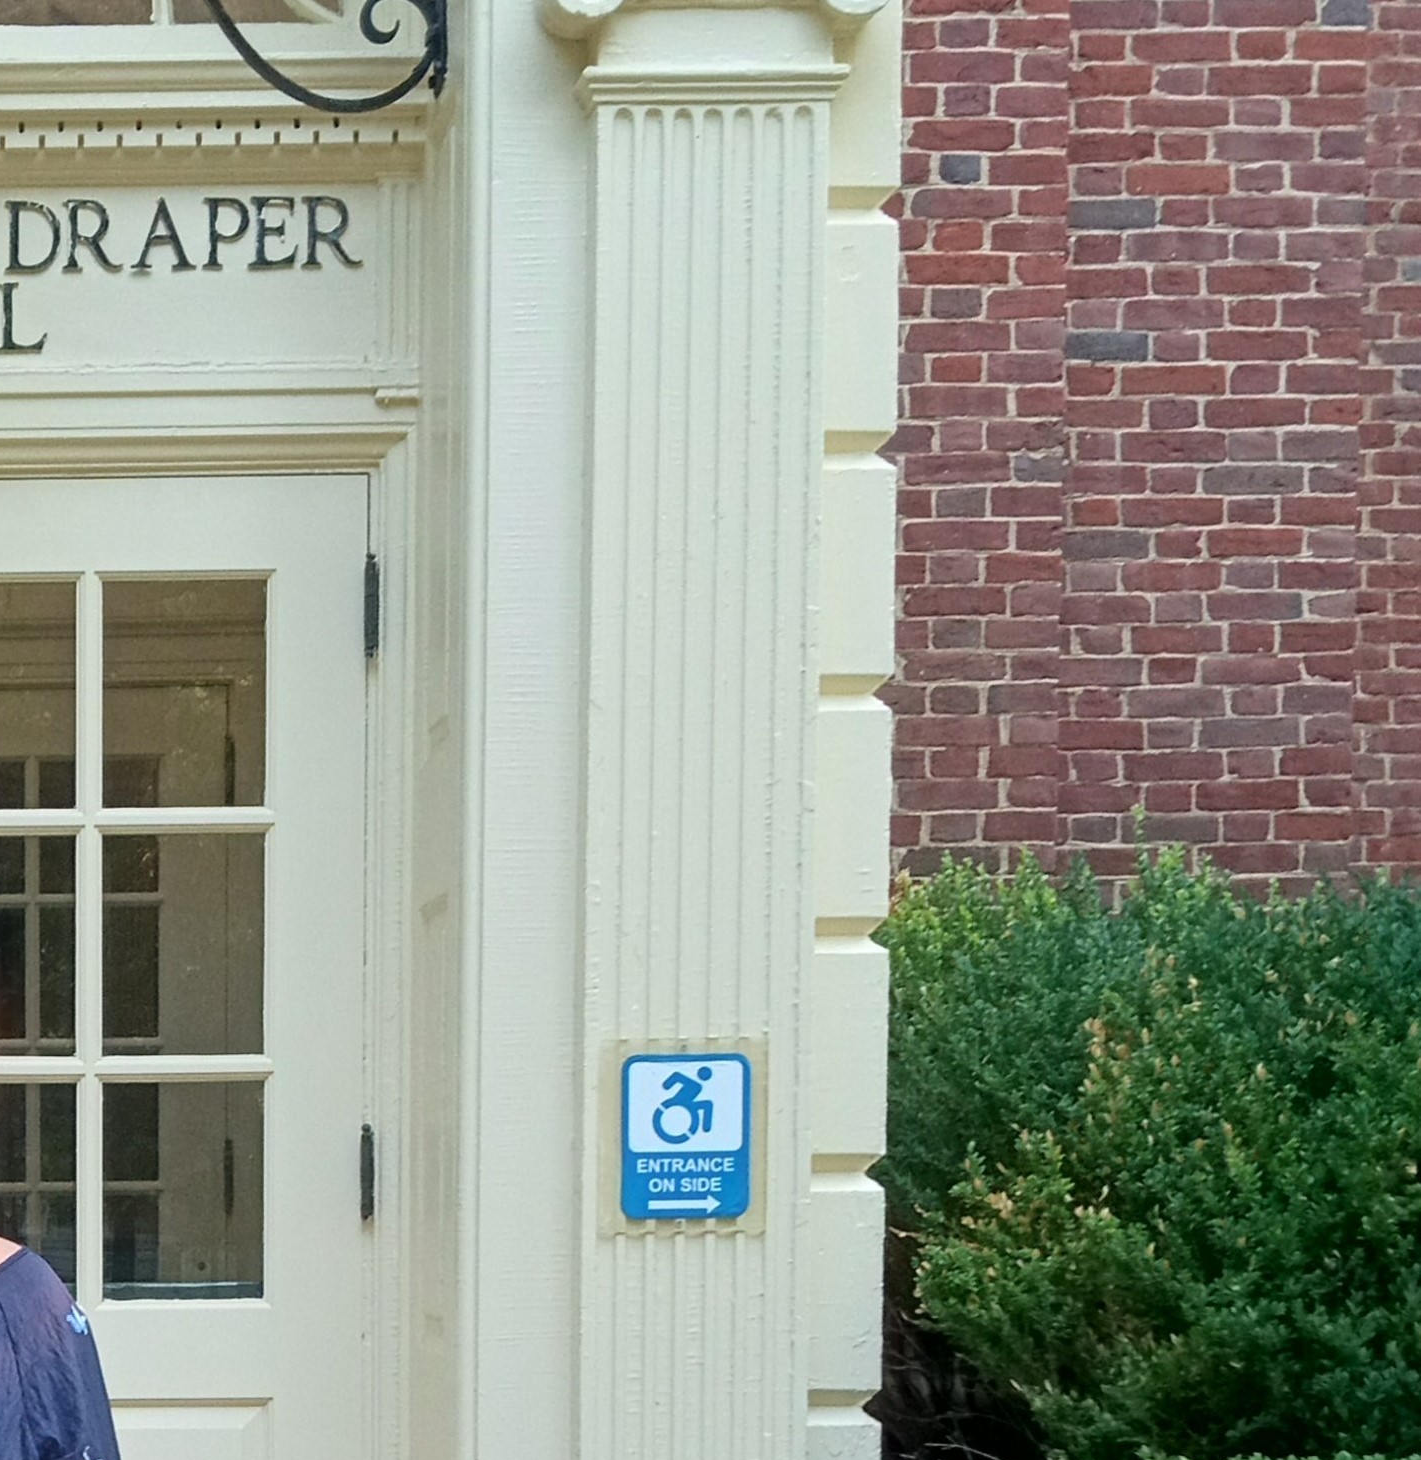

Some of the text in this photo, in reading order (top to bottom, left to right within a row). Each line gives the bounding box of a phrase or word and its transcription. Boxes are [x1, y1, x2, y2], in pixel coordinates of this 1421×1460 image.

[4, 196, 364, 275] DRAPER
[636, 1157, 735, 1174] ENTRANCE
[648, 1177, 722, 1193] ON SIDE
